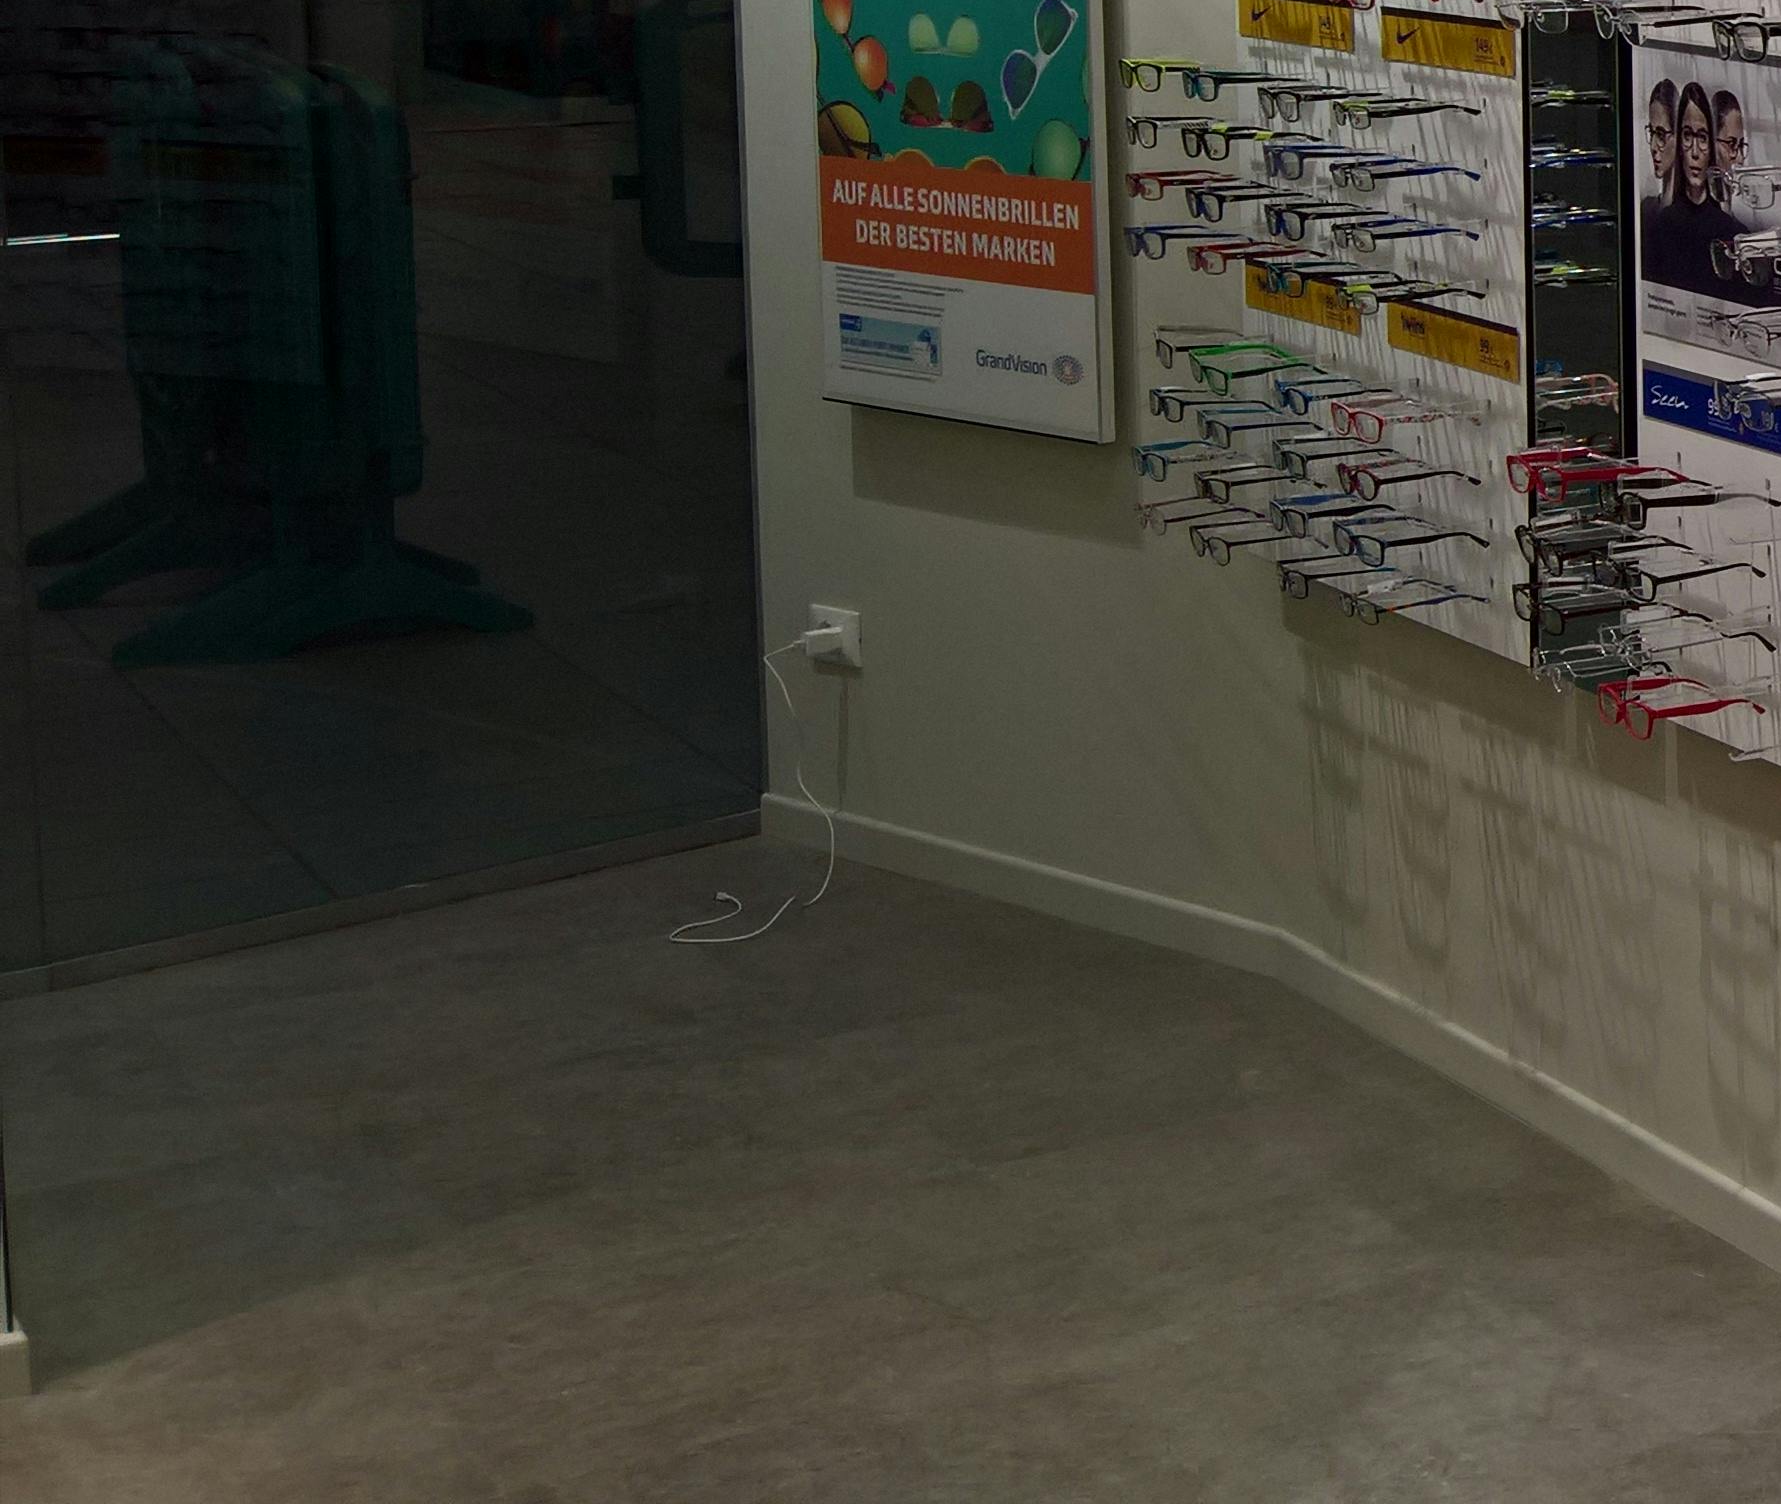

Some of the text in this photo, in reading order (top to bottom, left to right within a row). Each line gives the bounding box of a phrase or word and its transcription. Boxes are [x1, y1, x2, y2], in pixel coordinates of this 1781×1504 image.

[833, 179, 1079, 230] AUF ALLE SONNENBRILLEN
[855, 219, 1055, 267] DER BESTEN MARKEN
[976, 349, 1047, 376] GrandVision
